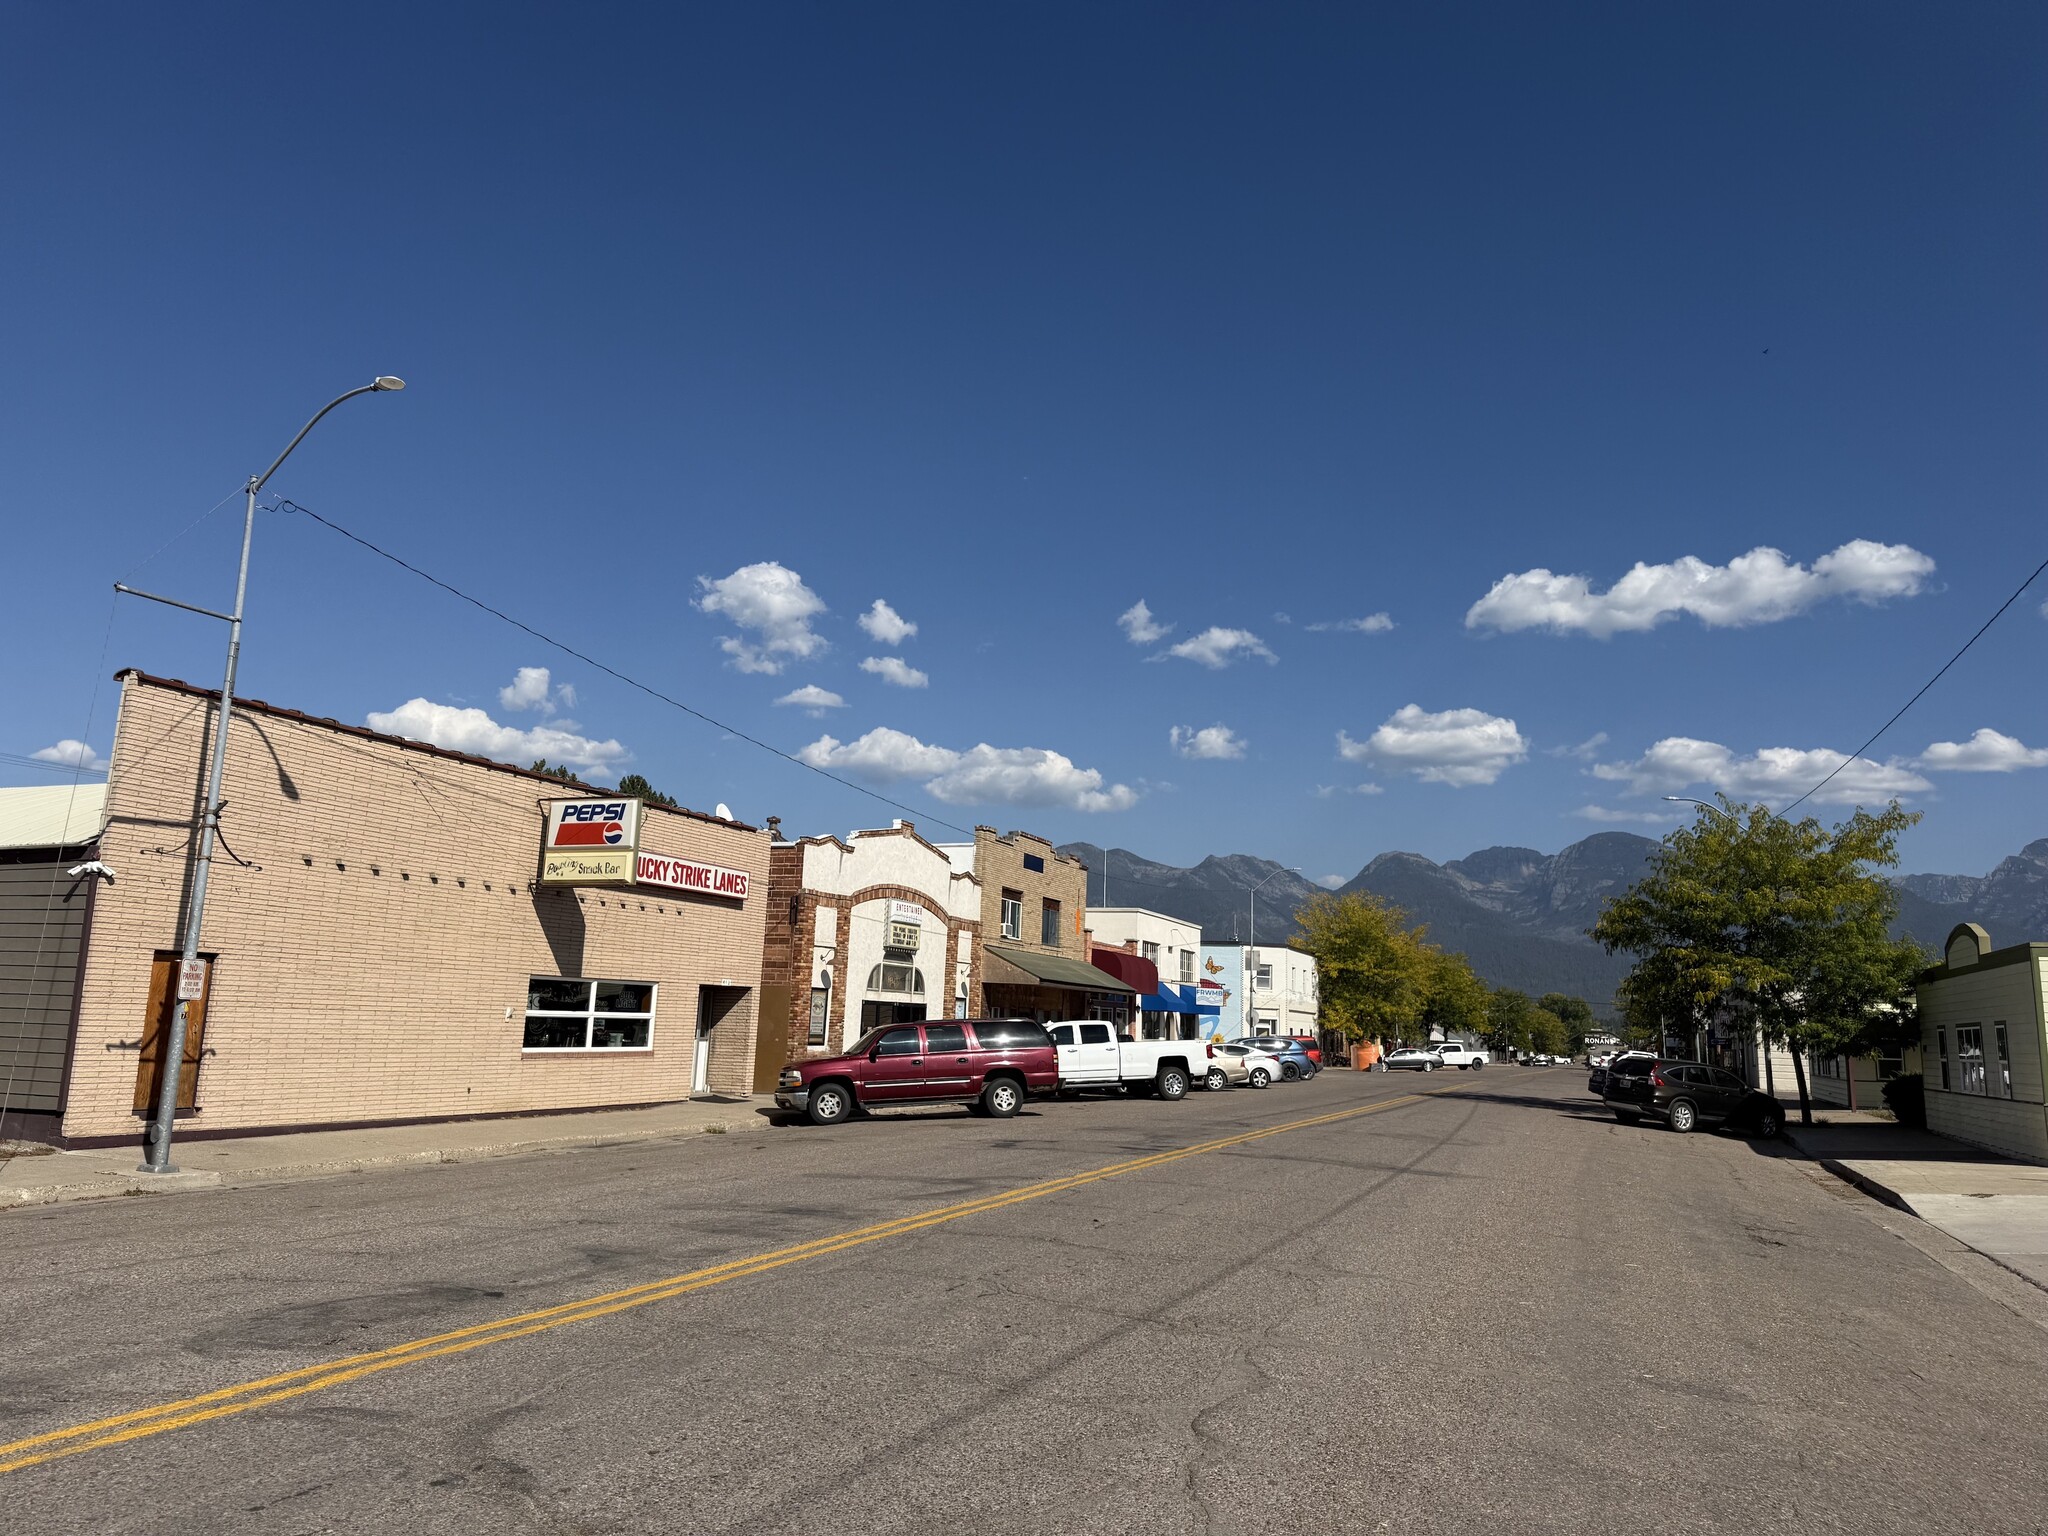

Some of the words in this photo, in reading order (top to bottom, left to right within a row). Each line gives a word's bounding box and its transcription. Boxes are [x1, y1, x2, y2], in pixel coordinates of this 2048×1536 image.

[561, 803, 626, 822] PEPSI
[578, 863, 602, 874] Snack
[605, 862, 620, 874] Bar
[637, 856, 670, 881] UCKY
[672, 861, 711, 887] STRIKE
[714, 869, 746, 895] LANES
[896, 903, 923, 915] ENTERTAINER
[183, 972, 202, 980] PARKING
[1584, 1037, 1610, 1045] RONAN
